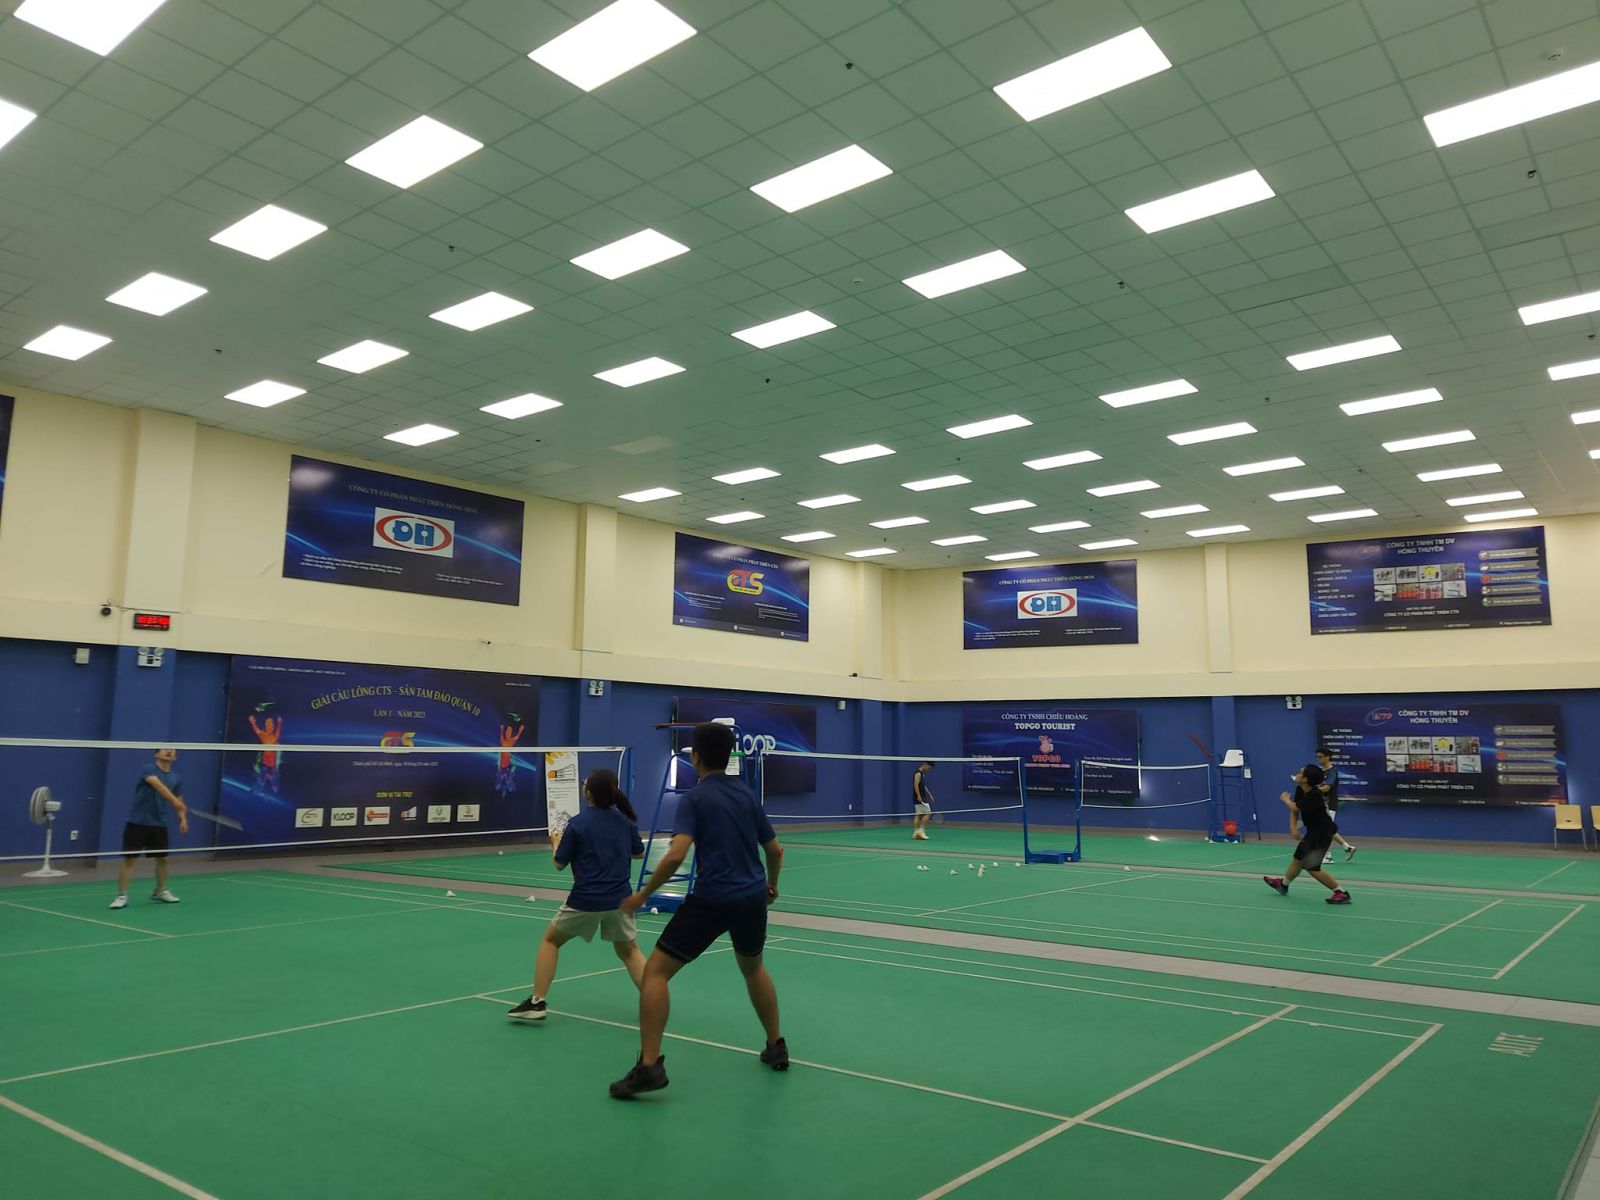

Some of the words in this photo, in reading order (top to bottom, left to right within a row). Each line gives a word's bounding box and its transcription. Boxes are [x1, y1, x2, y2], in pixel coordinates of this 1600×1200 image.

[1406, 540, 1414, 548] TY
[726, 568, 764, 596] CTS
[376, 686, 392, 696] CTS
[417, 688, 434, 699] TAM
[472, 705, 481, 717] 10
[1014, 722, 1040, 730] TOPGO
[1042, 722, 1076, 730] TOURIST
[731, 734, 776, 755] LOOP
